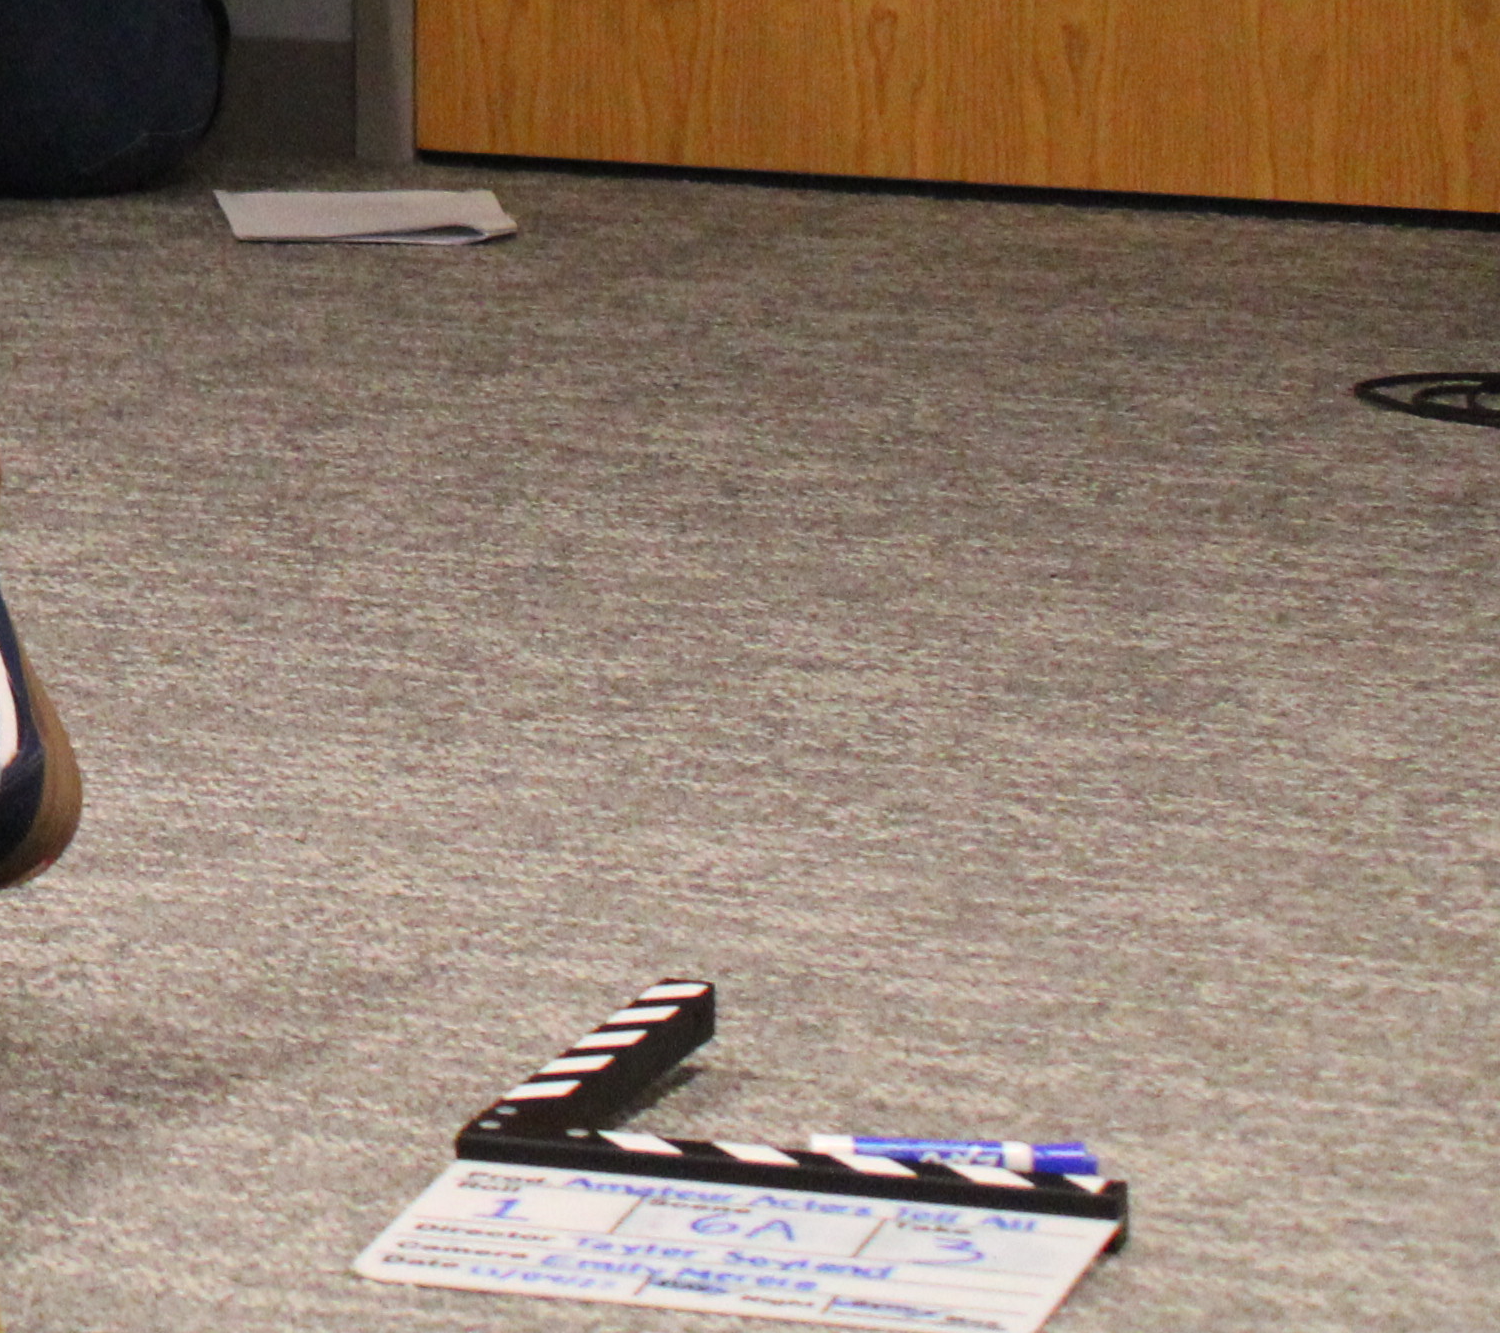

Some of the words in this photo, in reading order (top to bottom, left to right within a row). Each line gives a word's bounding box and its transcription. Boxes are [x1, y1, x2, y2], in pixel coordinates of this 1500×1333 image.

[566, 1178, 734, 1201] Amateur
[749, 1195, 871, 1216] Actors
[897, 1207, 960, 1225] Tell
[979, 1215, 1037, 1231] All
[650, 1198, 751, 1214] Scene
[414, 1222, 556, 1242] Director
[397, 1240, 528, 1259] Camera
[912, 1236, 985, 1265] 3
[382, 1253, 460, 1269] Date
